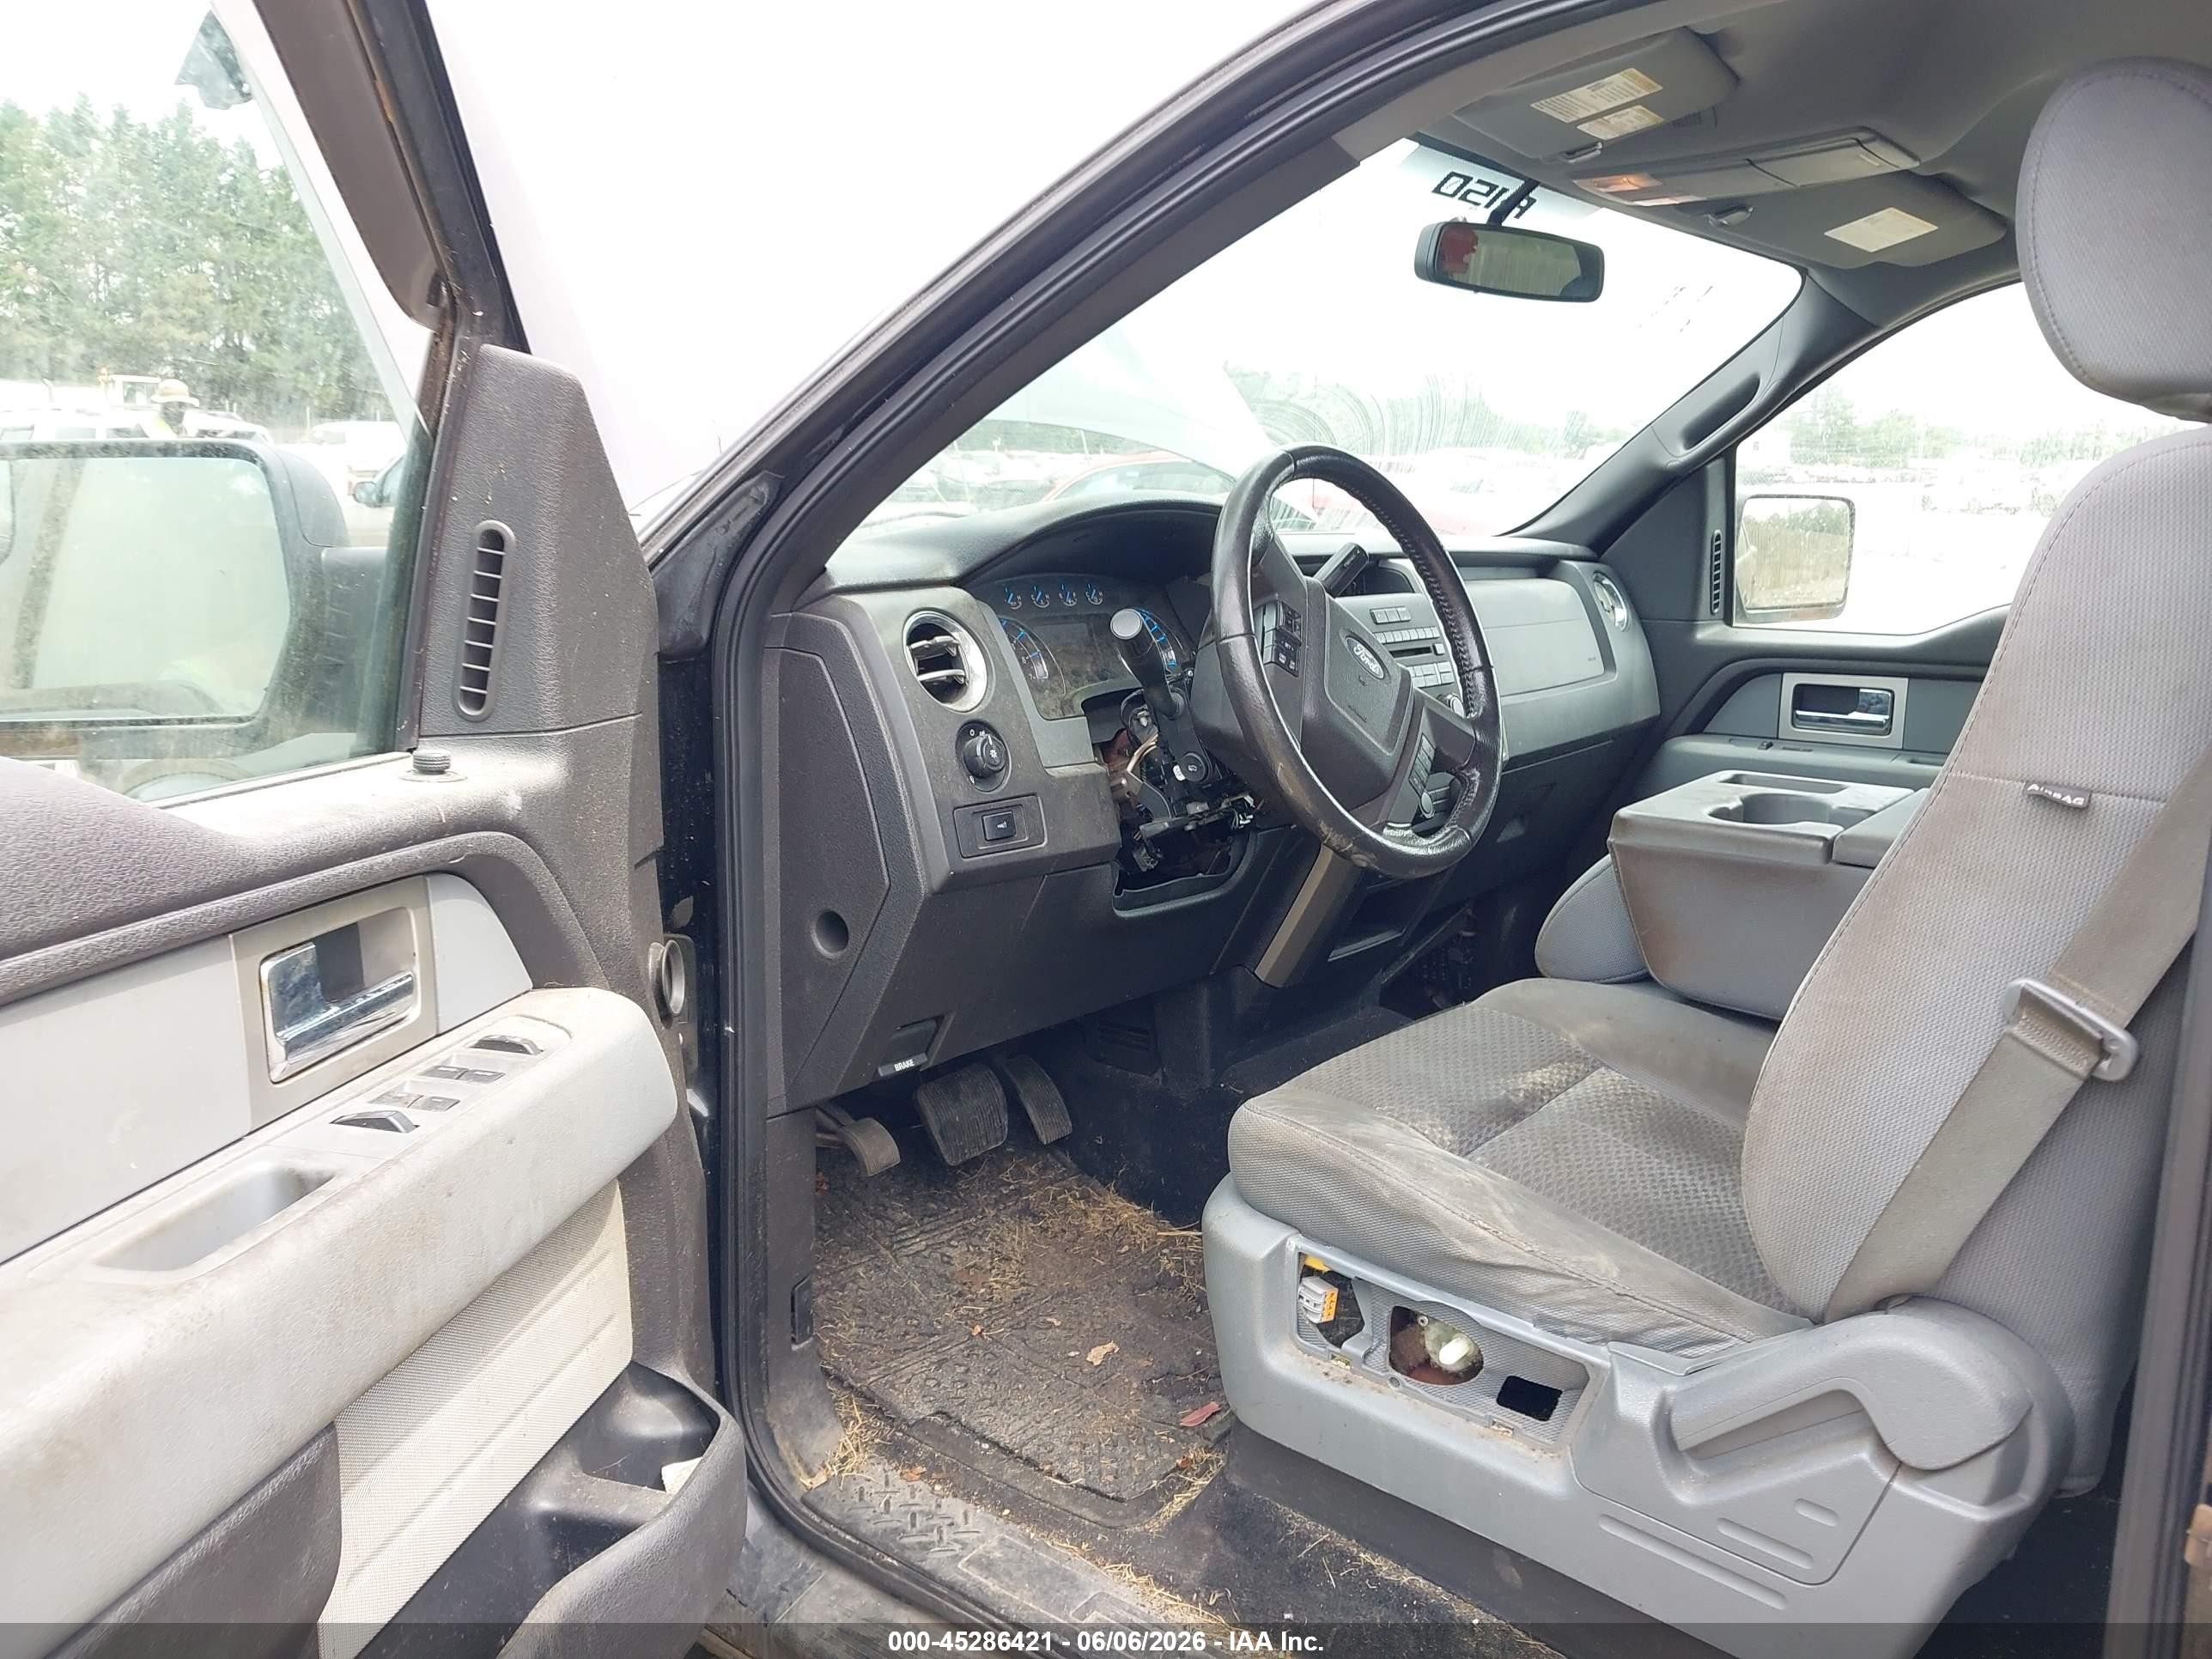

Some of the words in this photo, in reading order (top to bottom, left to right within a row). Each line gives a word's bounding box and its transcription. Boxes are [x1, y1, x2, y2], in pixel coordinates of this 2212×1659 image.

[1352, 643, 1381, 676] Ford
[2026, 783, 2085, 806] AIRBAG
[894, 1059, 915, 1072] BRAKE
